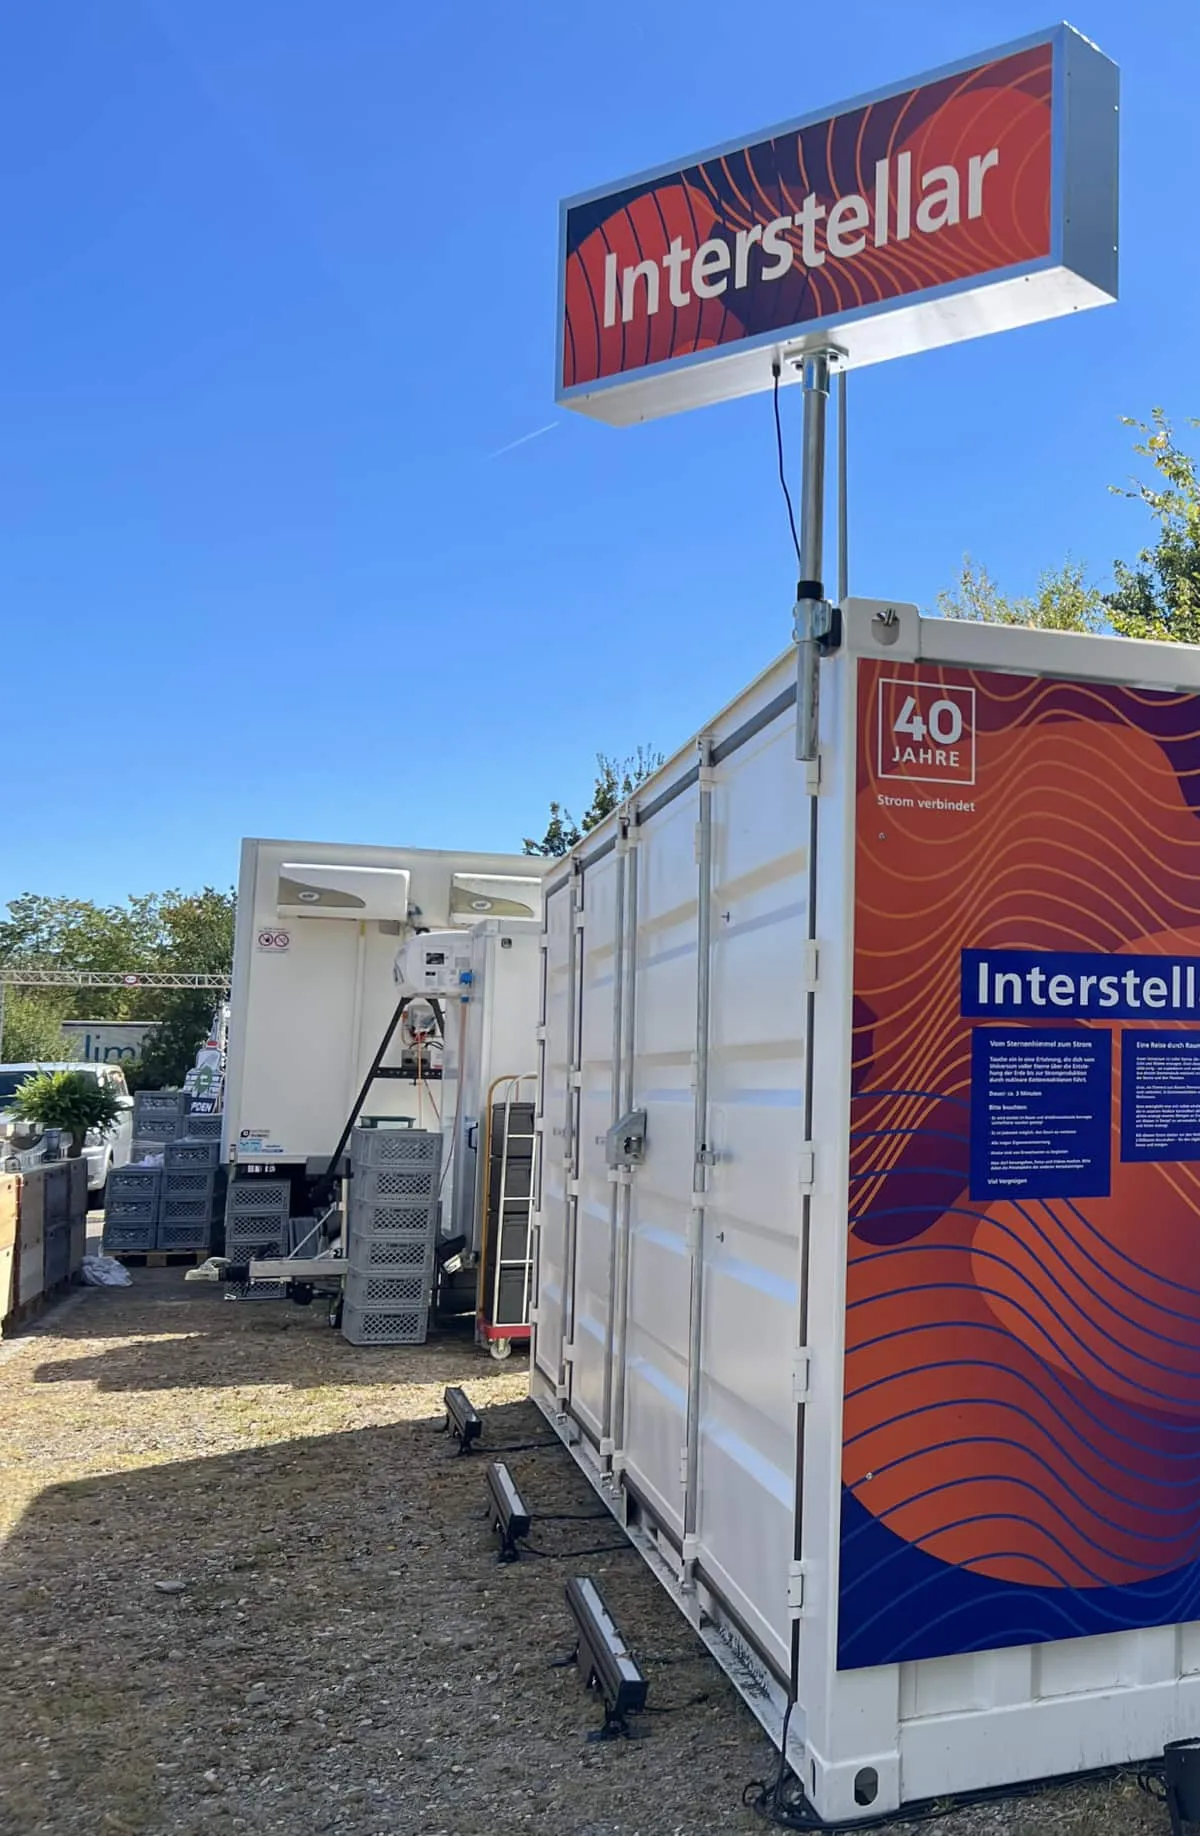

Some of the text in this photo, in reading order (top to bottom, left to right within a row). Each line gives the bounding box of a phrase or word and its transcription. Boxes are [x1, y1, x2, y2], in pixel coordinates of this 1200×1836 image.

[603, 147, 999, 328] Interstellar
[893, 695, 962, 744] 40
[892, 746, 960, 767] JAHRE
[877, 794, 975, 812] Strom verbindet
